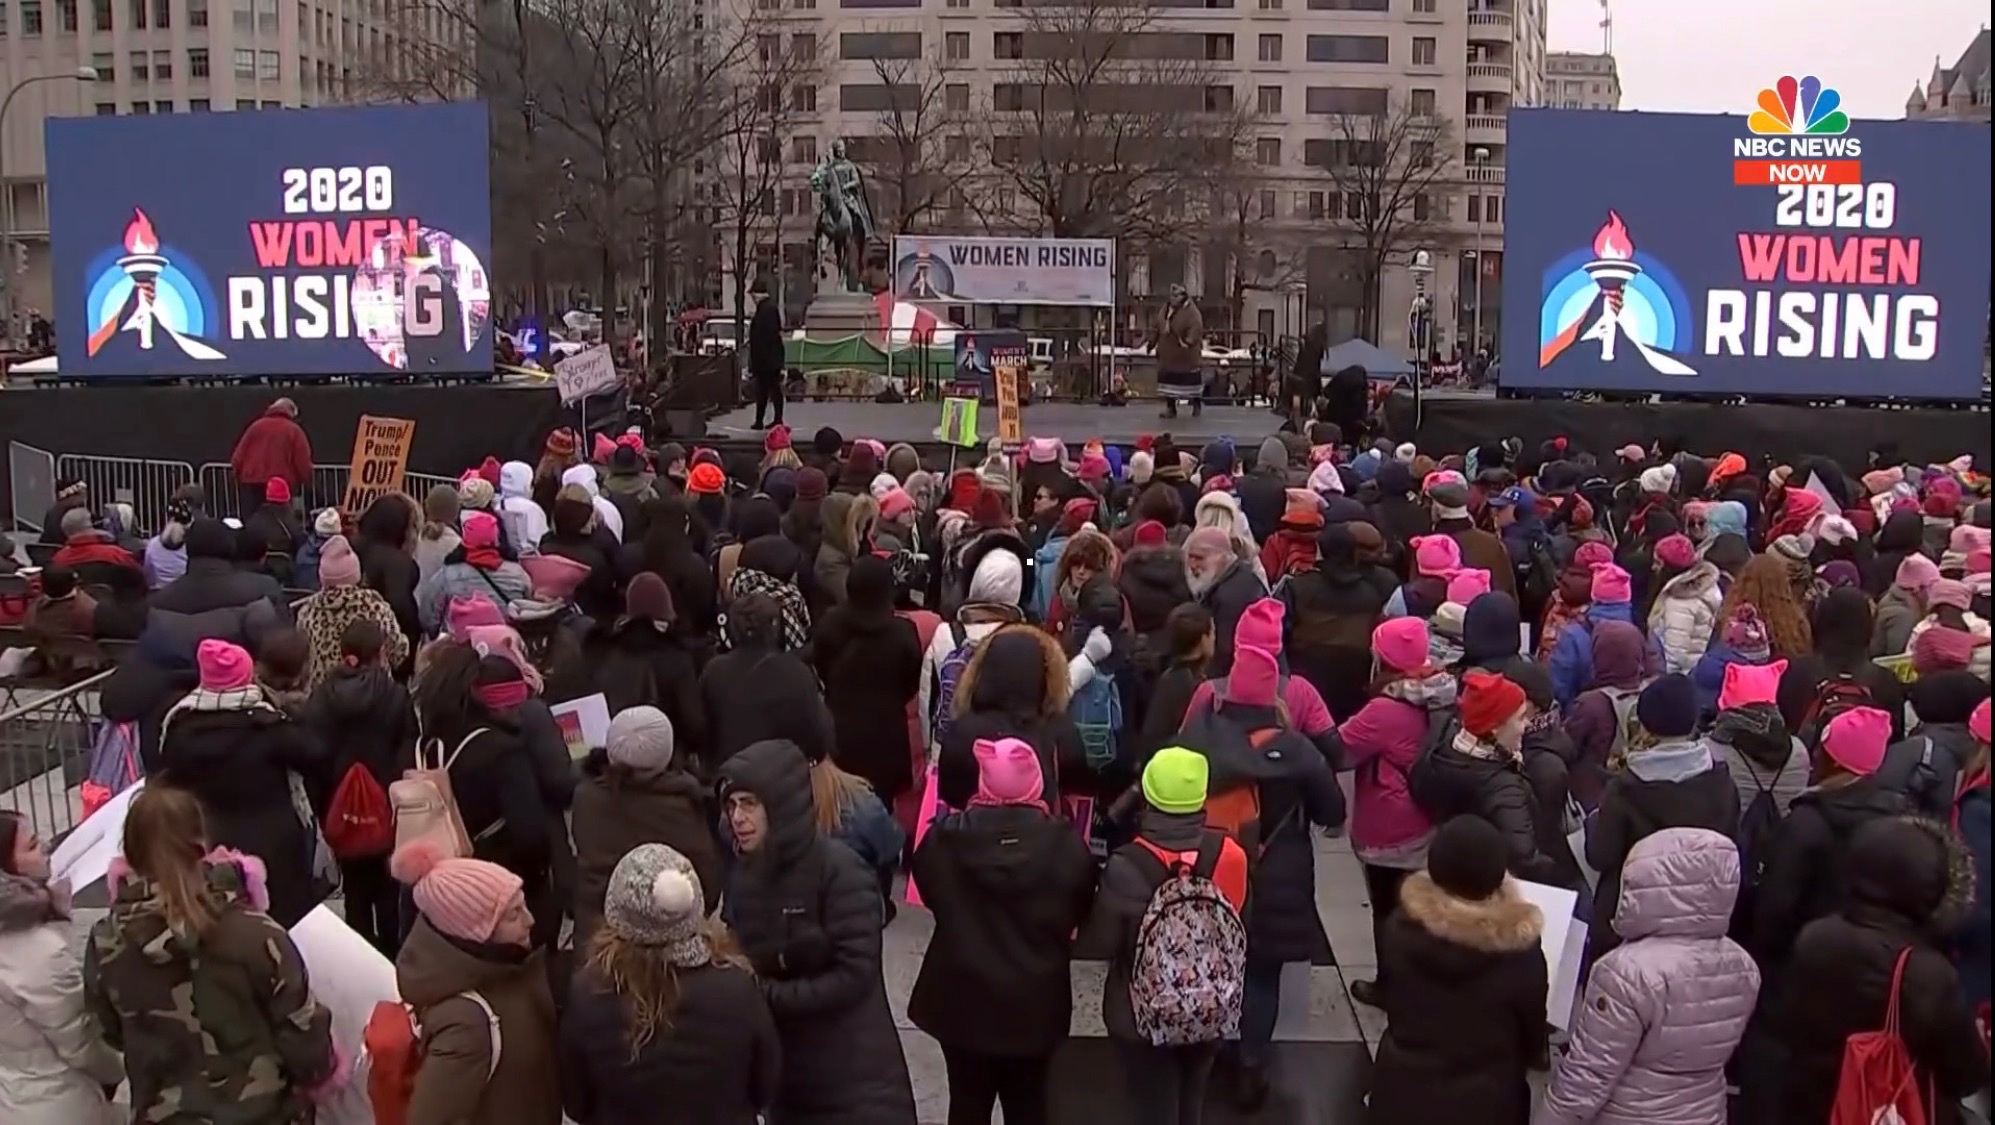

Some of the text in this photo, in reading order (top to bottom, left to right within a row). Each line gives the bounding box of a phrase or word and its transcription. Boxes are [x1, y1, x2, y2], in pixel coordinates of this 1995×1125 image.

[283, 165, 392, 213] 2020
[1776, 182, 1896, 229] 2020
[949, 245, 1107, 268] WOMEN RISING
[1738, 233, 1921, 285] WOMEN
[228, 274, 444, 339] RISIG
[1705, 289, 1940, 361] RISING
[990, 355, 1028, 367] MARCH
[362, 459, 399, 485] OUT
